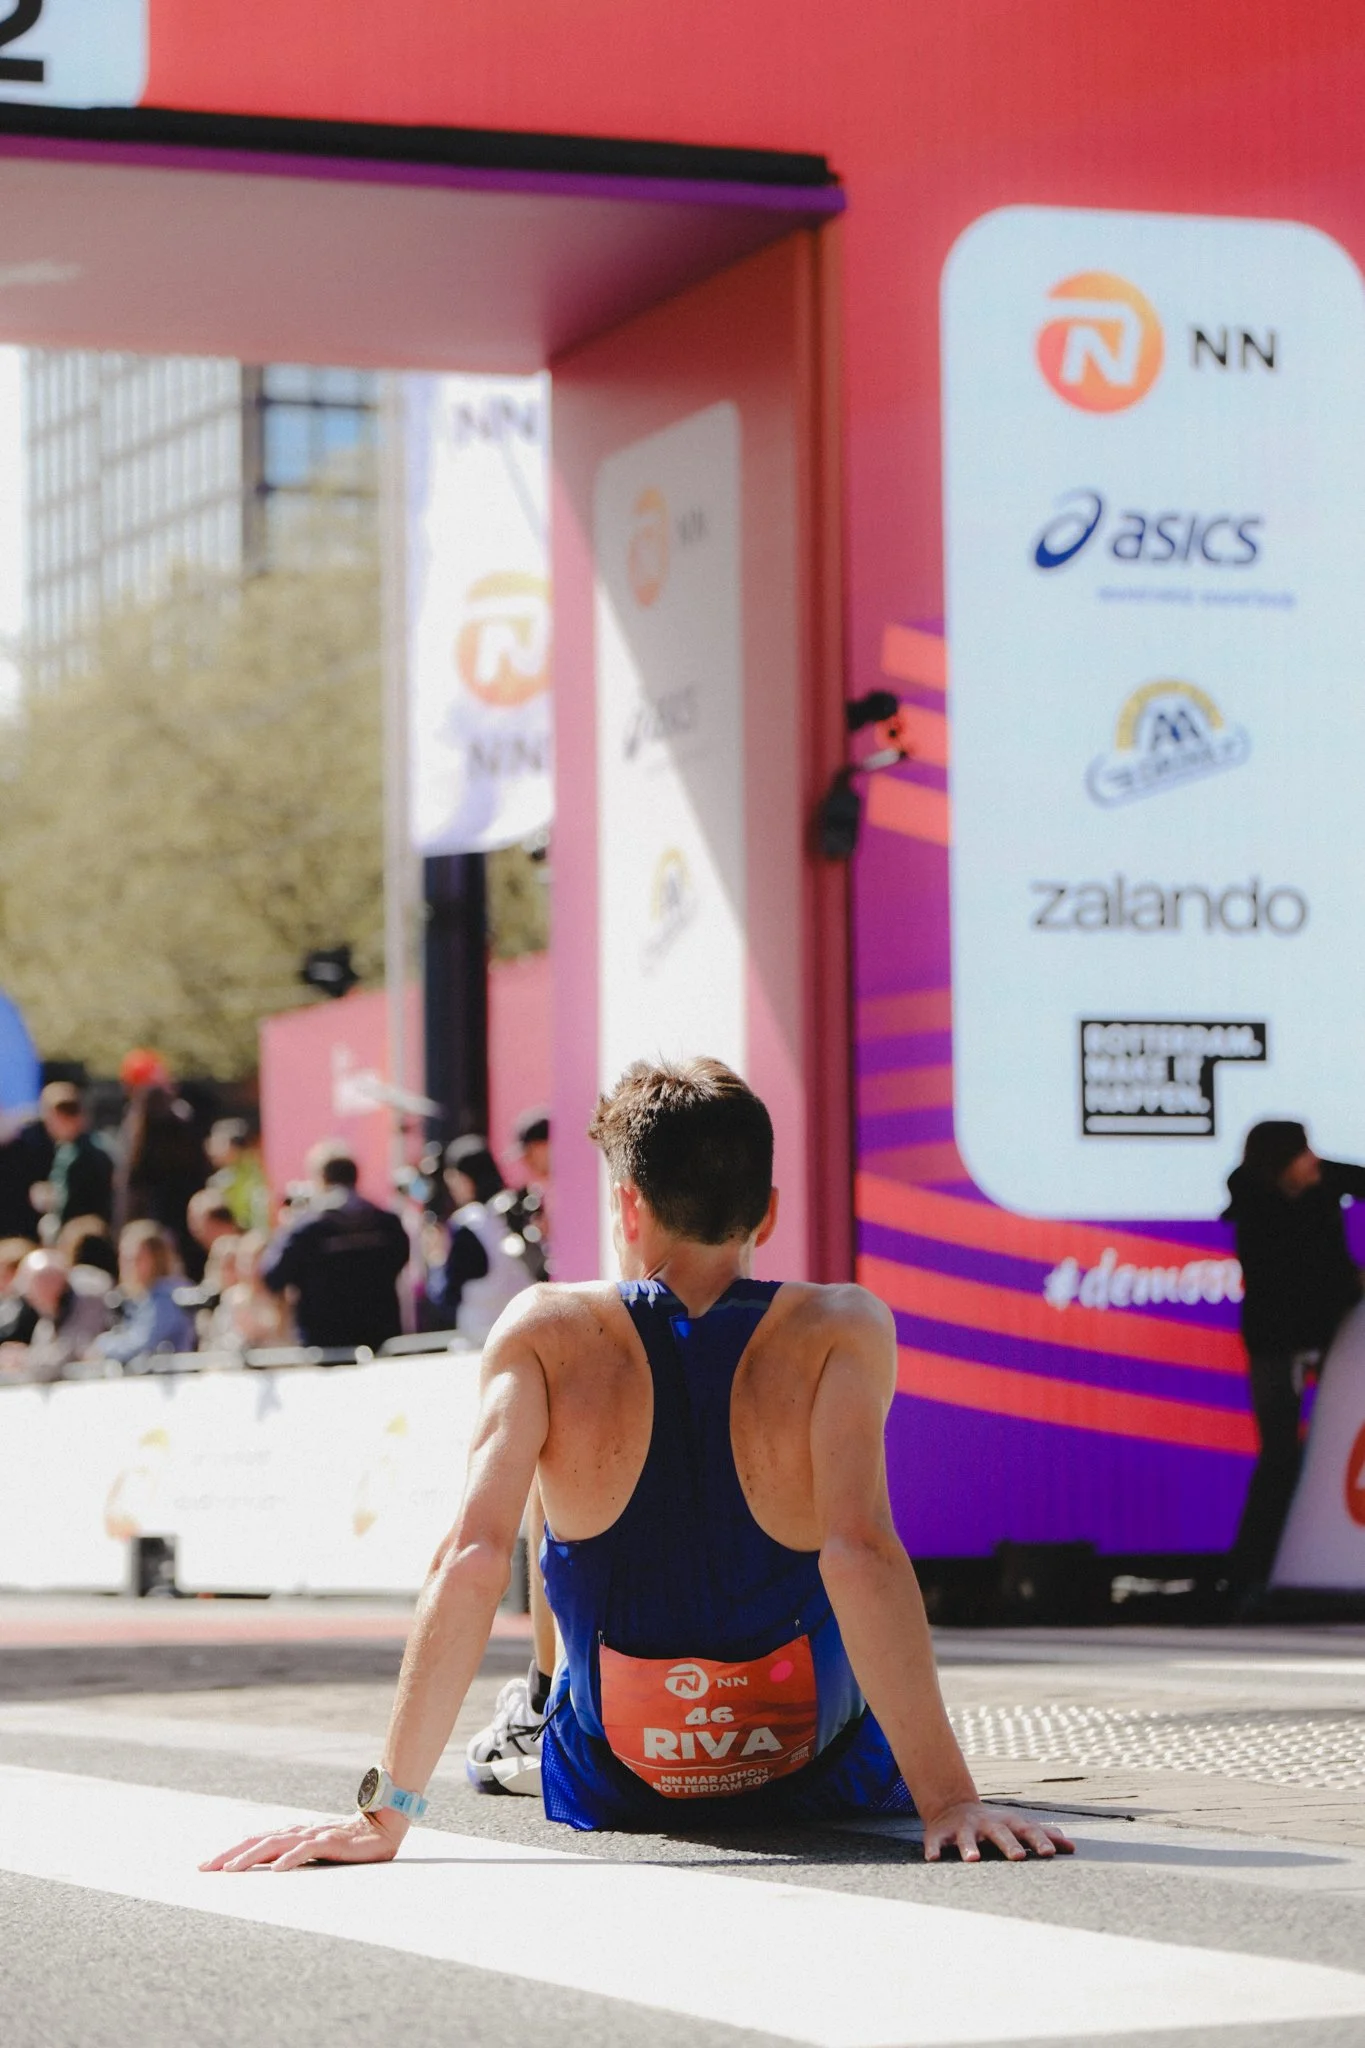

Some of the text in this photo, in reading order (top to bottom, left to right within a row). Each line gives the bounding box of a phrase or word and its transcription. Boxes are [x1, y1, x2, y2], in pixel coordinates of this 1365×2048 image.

[1191, 325, 1279, 372] NN
[1110, 512, 1266, 568] asics
[1031, 875, 1308, 936] zalando
[717, 1677, 748, 1688] NN
[685, 1706, 735, 1725] 46
[643, 1727, 783, 1760] RIVA
[653, 1781, 742, 1794] ROTTERDAM
[661, 1767, 769, 1785] NN MARATHON
